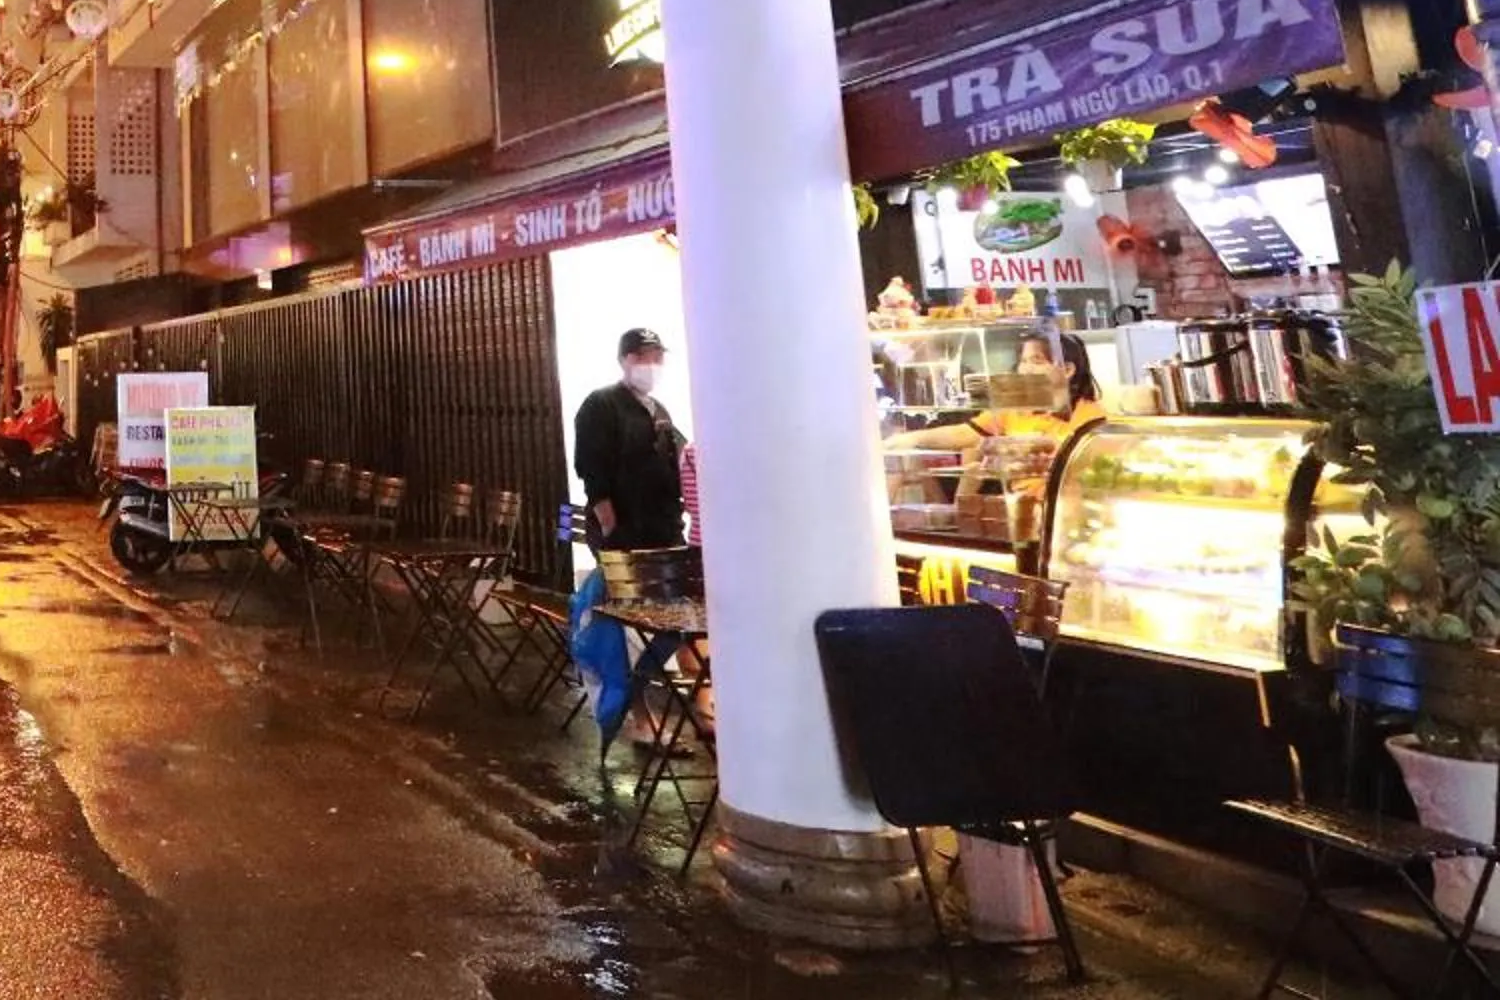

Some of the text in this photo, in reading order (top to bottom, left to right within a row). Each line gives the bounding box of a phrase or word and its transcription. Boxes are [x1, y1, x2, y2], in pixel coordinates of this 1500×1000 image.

[911, 44, 1063, 127] TRÀ
[966, 118, 1000, 147] 175
[1006, 104, 1066, 137] PHẠM
[514, 204, 567, 247] SINH
[1424, 284, 1500, 424] LA
